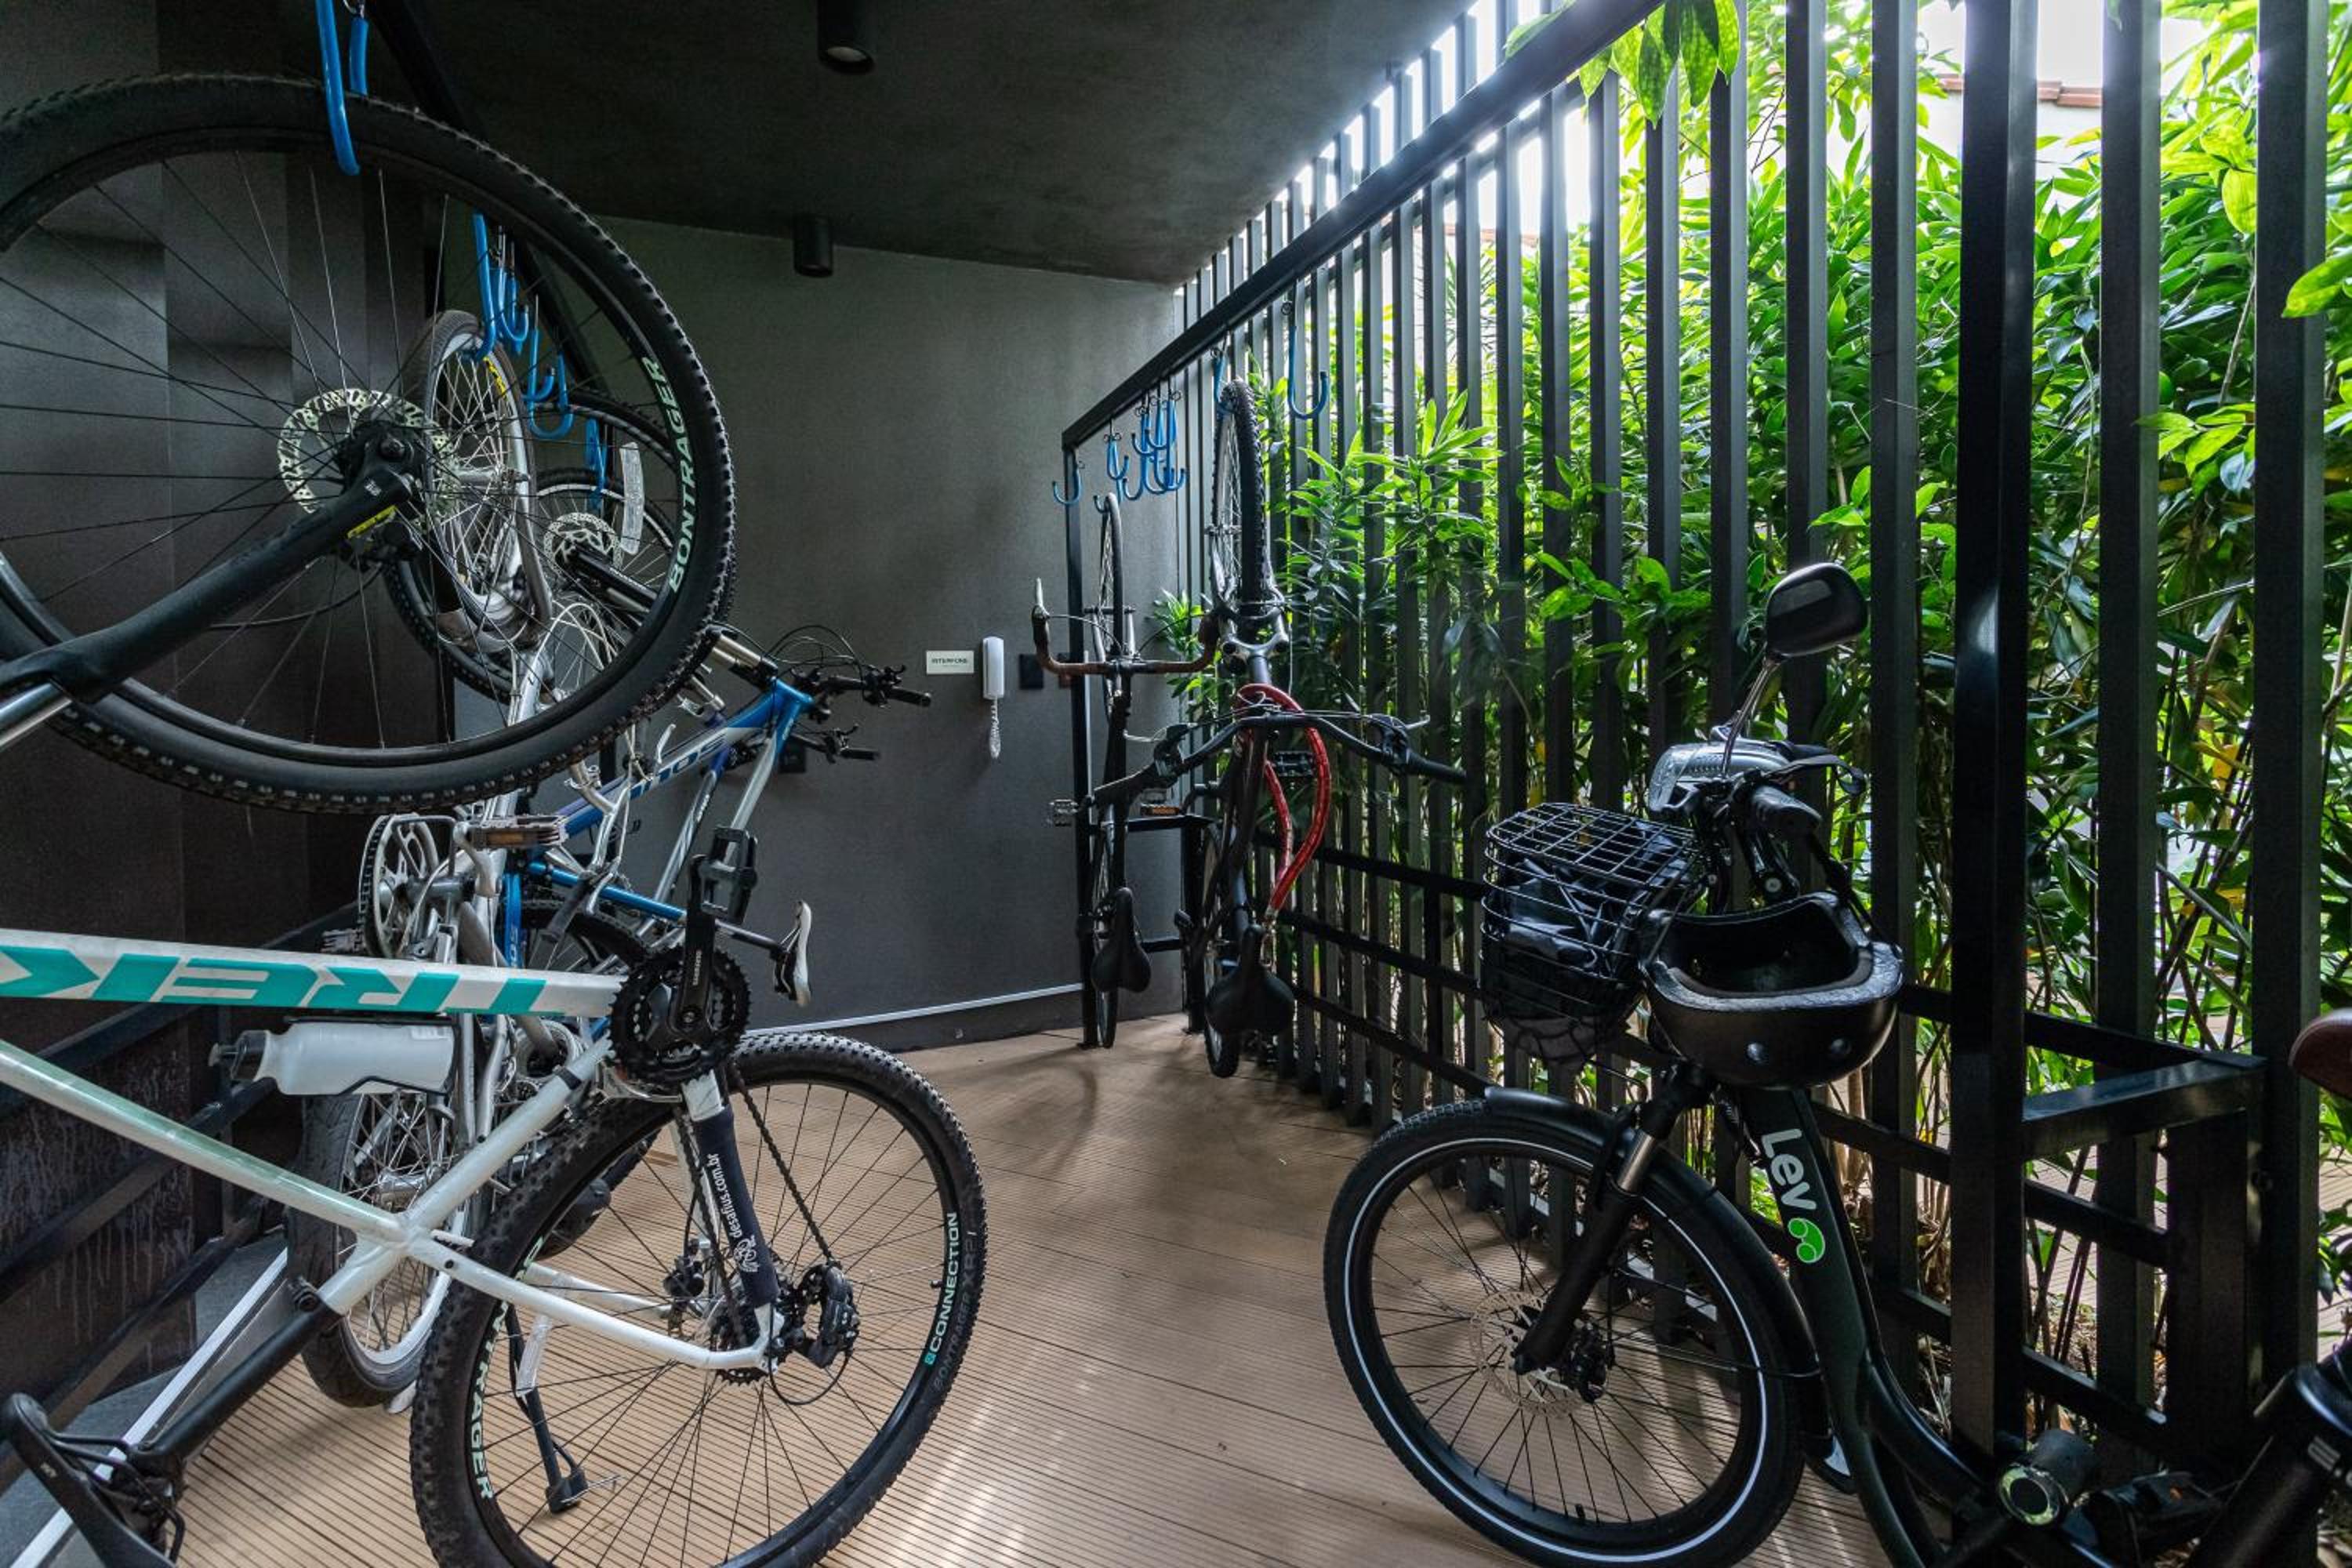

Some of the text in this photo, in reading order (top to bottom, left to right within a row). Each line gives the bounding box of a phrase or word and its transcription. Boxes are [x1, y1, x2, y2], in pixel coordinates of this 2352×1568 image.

[641, 357, 696, 593] BONTRAGER
[0, 946, 564, 1014] TREK
[1762, 1128, 1817, 1210] Lev
[929, 1212, 959, 1353] CONNECTION
